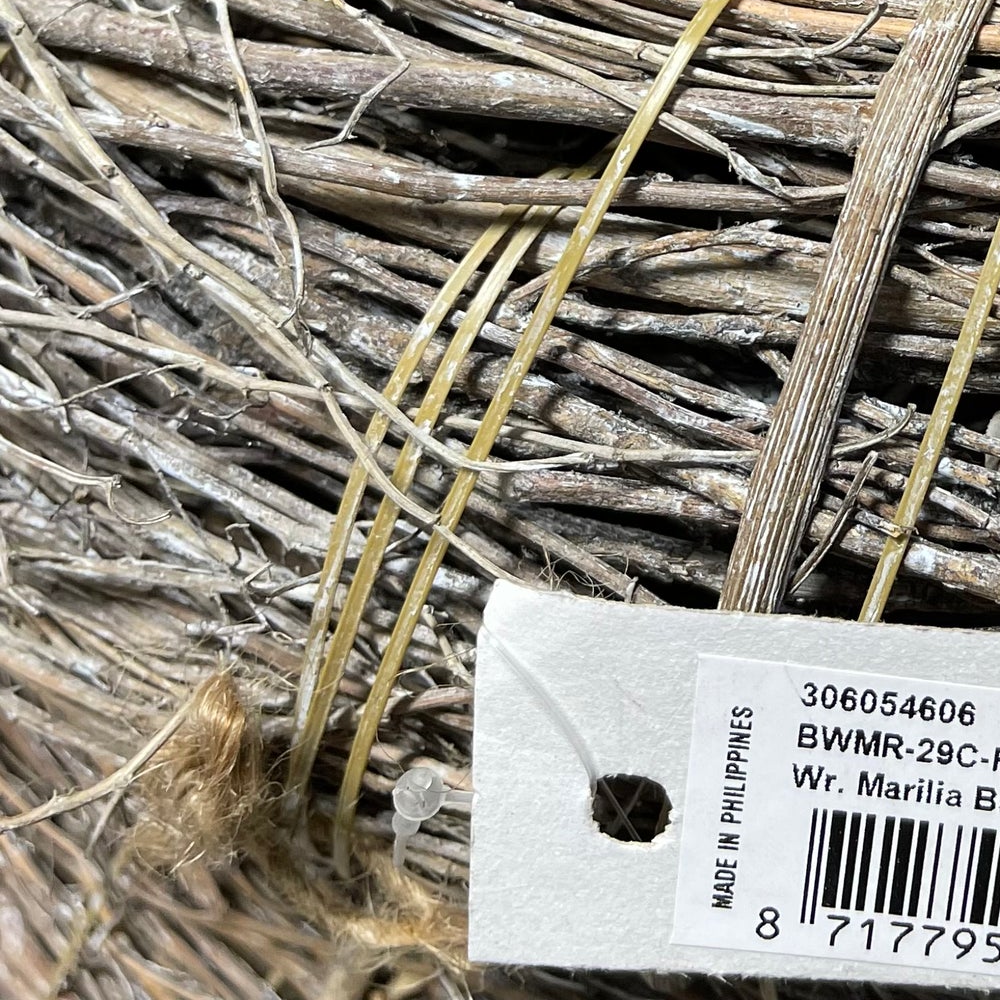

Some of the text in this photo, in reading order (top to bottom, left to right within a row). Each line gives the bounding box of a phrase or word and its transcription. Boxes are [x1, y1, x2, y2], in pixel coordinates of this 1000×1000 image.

[800, 682, 977, 727] 306054606
[711, 705, 754, 910] MADE IN PHILIPPINES
[792, 763, 844, 795] Wr.
[857, 770, 962, 808] Marilia
[755, 906, 780, 940] 8
